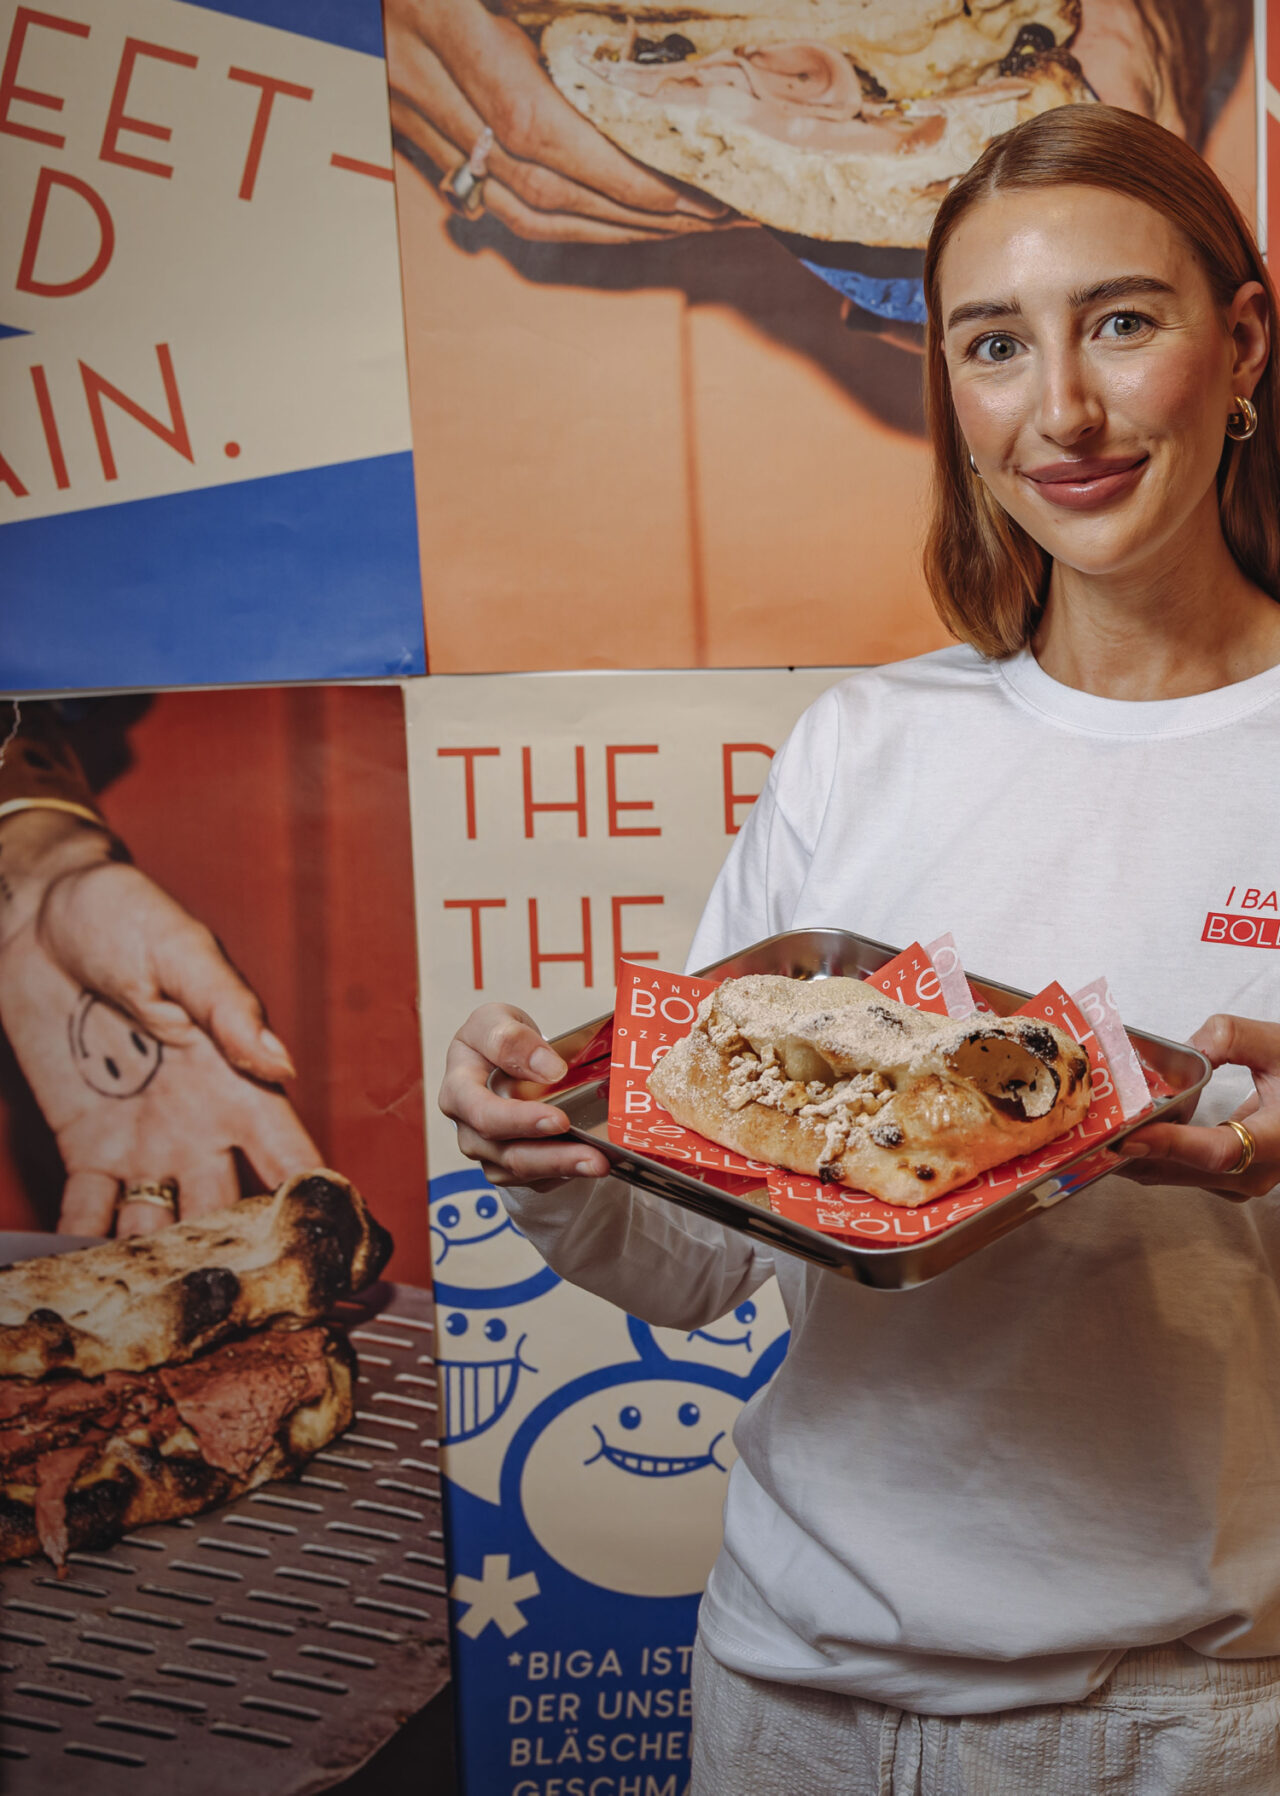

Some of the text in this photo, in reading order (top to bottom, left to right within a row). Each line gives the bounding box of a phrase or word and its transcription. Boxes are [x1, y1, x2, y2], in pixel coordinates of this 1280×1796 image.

[15, 167, 115, 298] D
[0, 343, 241, 497] IN.
[437, 744, 662, 840] THE
[1225, 886, 1236, 907] I
[508, 1693, 581, 1724] DER
[509, 1728, 693, 1767] BLÄSCHE
